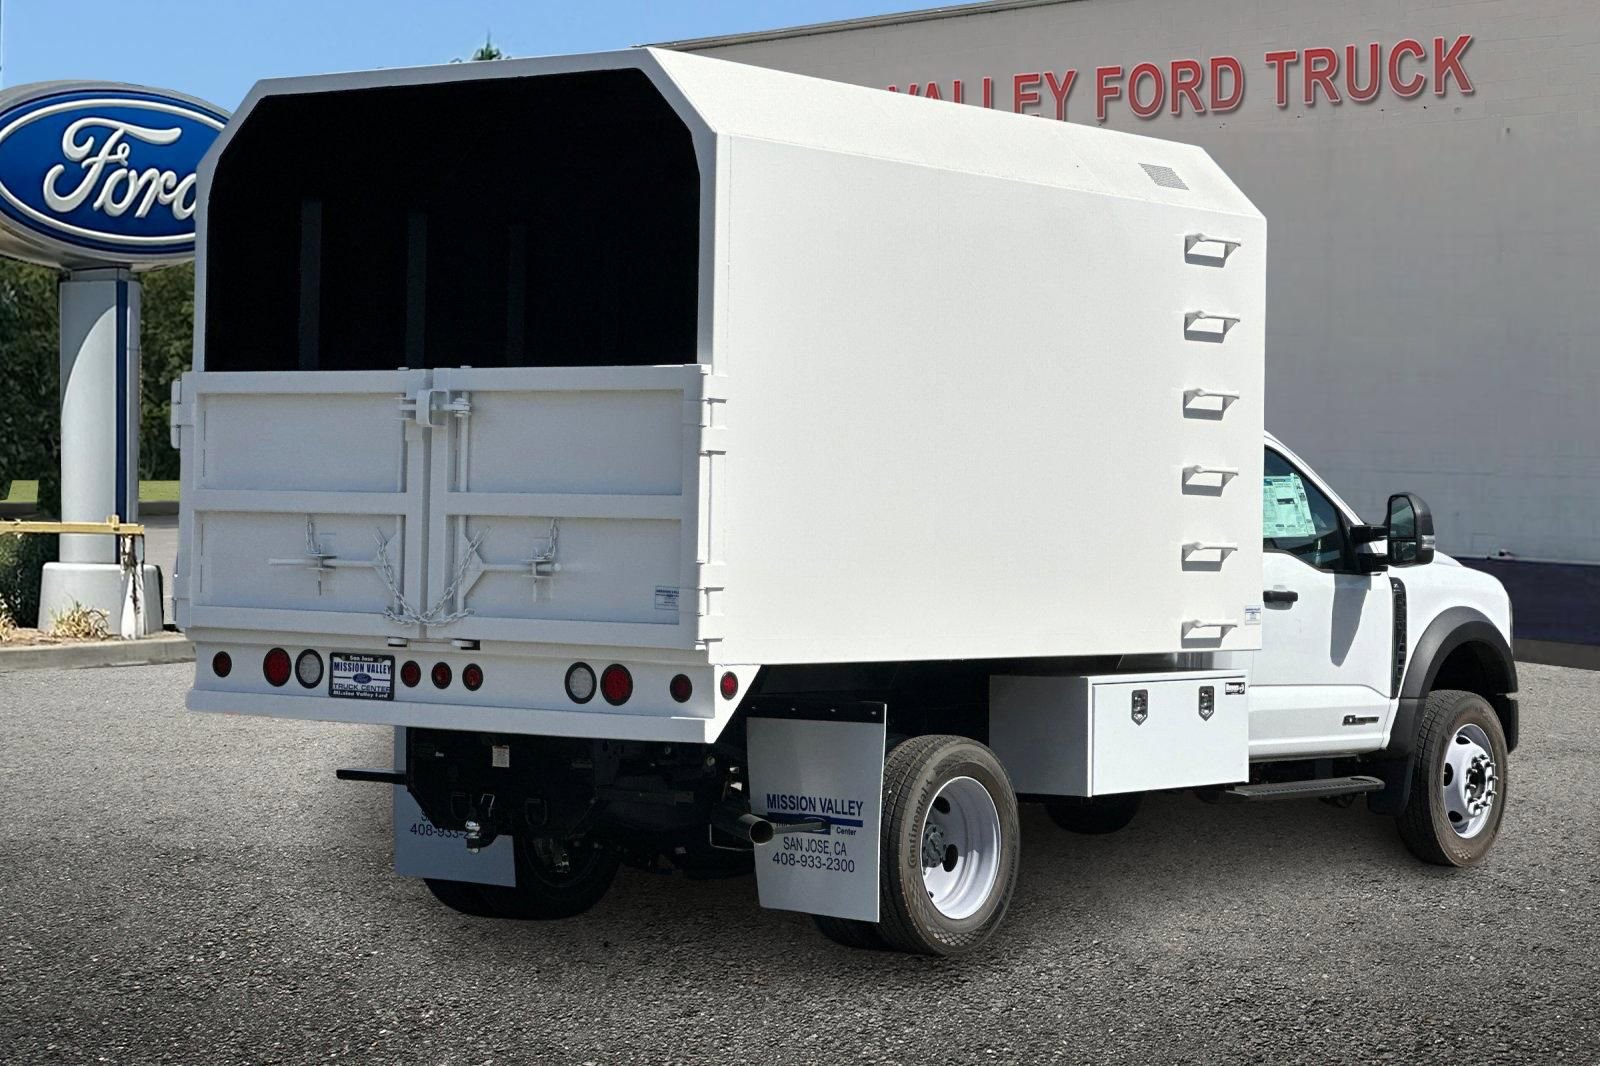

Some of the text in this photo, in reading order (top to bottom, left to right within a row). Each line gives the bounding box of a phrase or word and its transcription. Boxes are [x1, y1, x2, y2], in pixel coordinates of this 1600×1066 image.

[888, 34, 1474, 121] LEY FORD TRUCK
[334, 662, 391, 674] MISSION VALLEY
[766, 793, 863, 816] MISSION VALLEY
[836, 826, 857, 836] Center
[783, 836, 847, 857] SAN JOSE, CA
[772, 851, 855, 873] 408-933-2300
